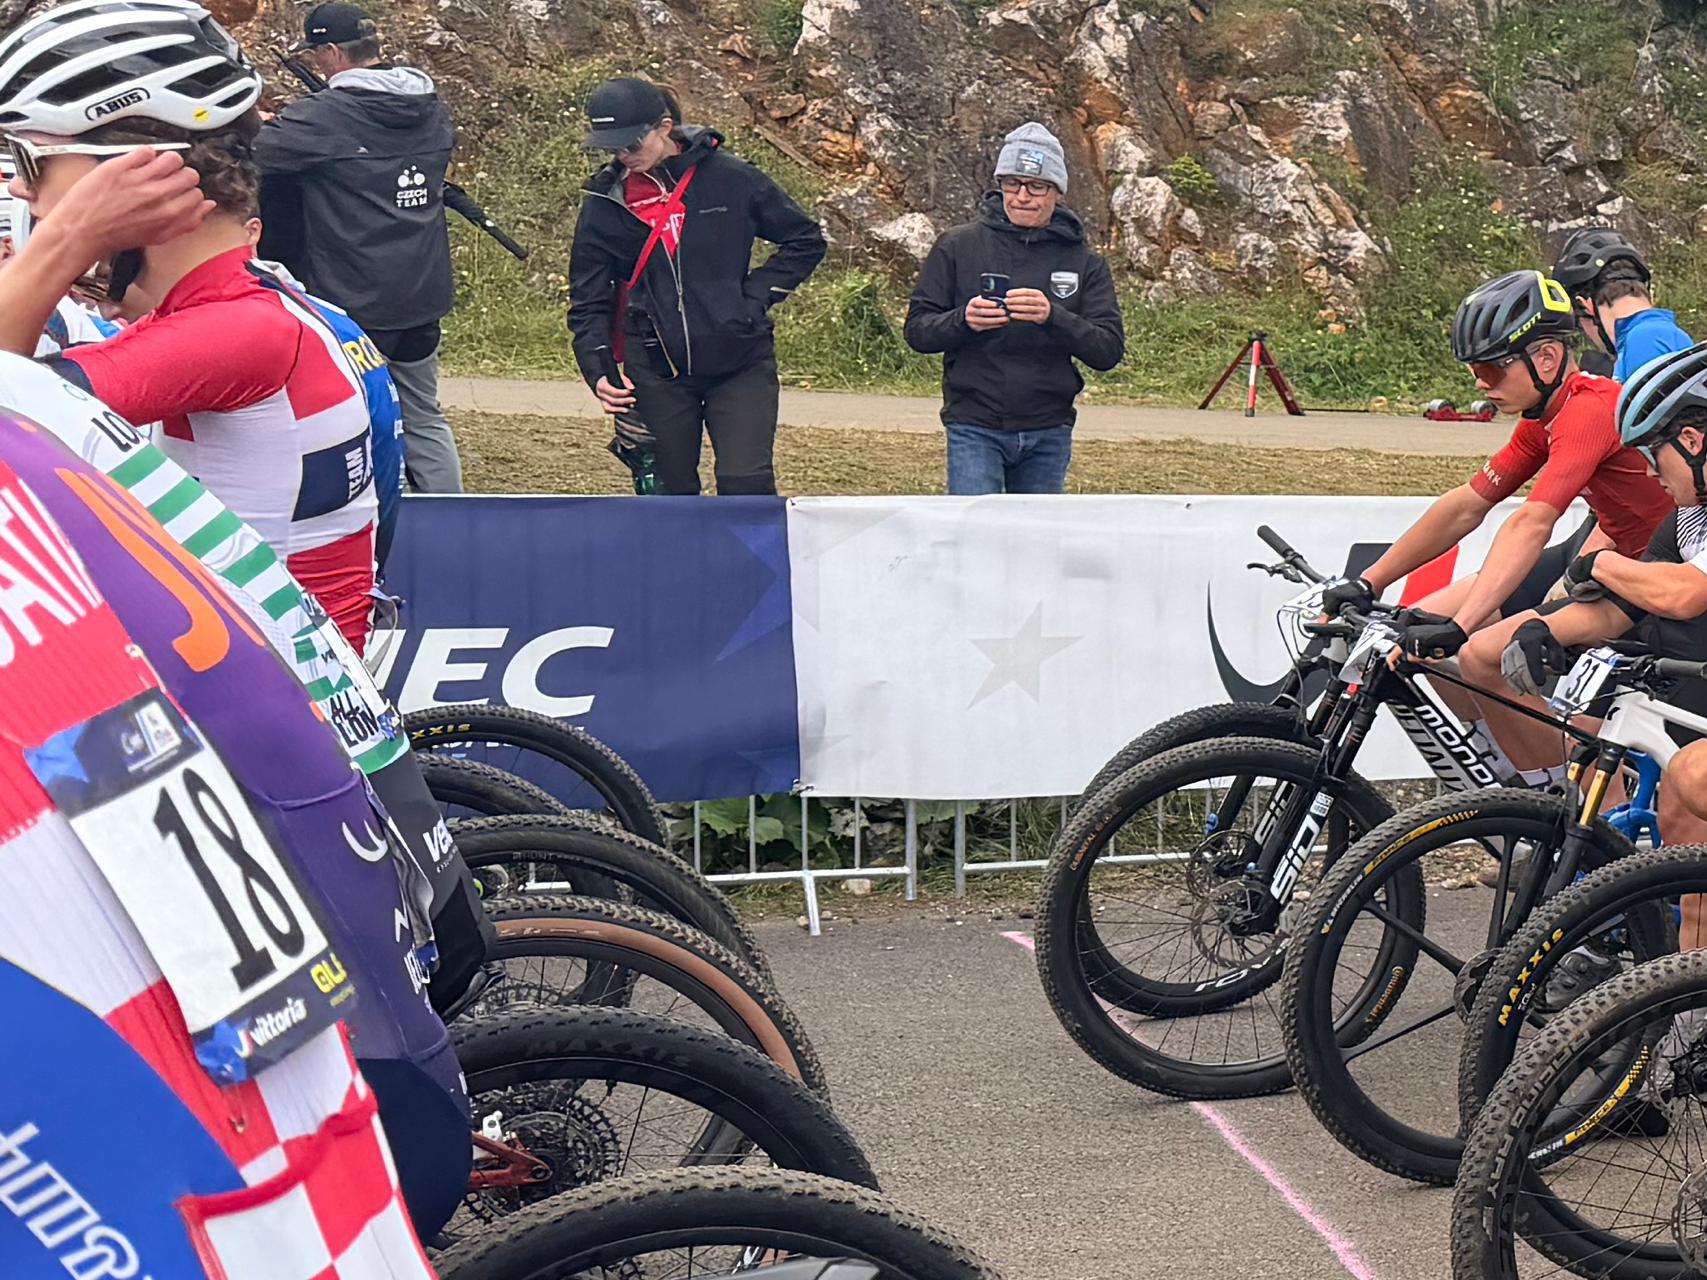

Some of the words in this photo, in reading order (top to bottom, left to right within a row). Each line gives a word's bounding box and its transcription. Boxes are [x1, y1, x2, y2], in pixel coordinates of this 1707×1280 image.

[94, 90, 143, 118] ABUS
[396, 189, 428, 200] CZECH
[396, 198, 428, 208] TEAM
[1509, 312, 1542, 343] SCOTT
[344, 447, 364, 499] TEAM
[1566, 659, 1599, 701] 31
[412, 722, 471, 741] XXIS
[1270, 812, 1320, 904] SID
[153, 767, 305, 992] 18
[1497, 926, 1564, 1025] MAXXIS
[250, 996, 307, 1047] vittoria
